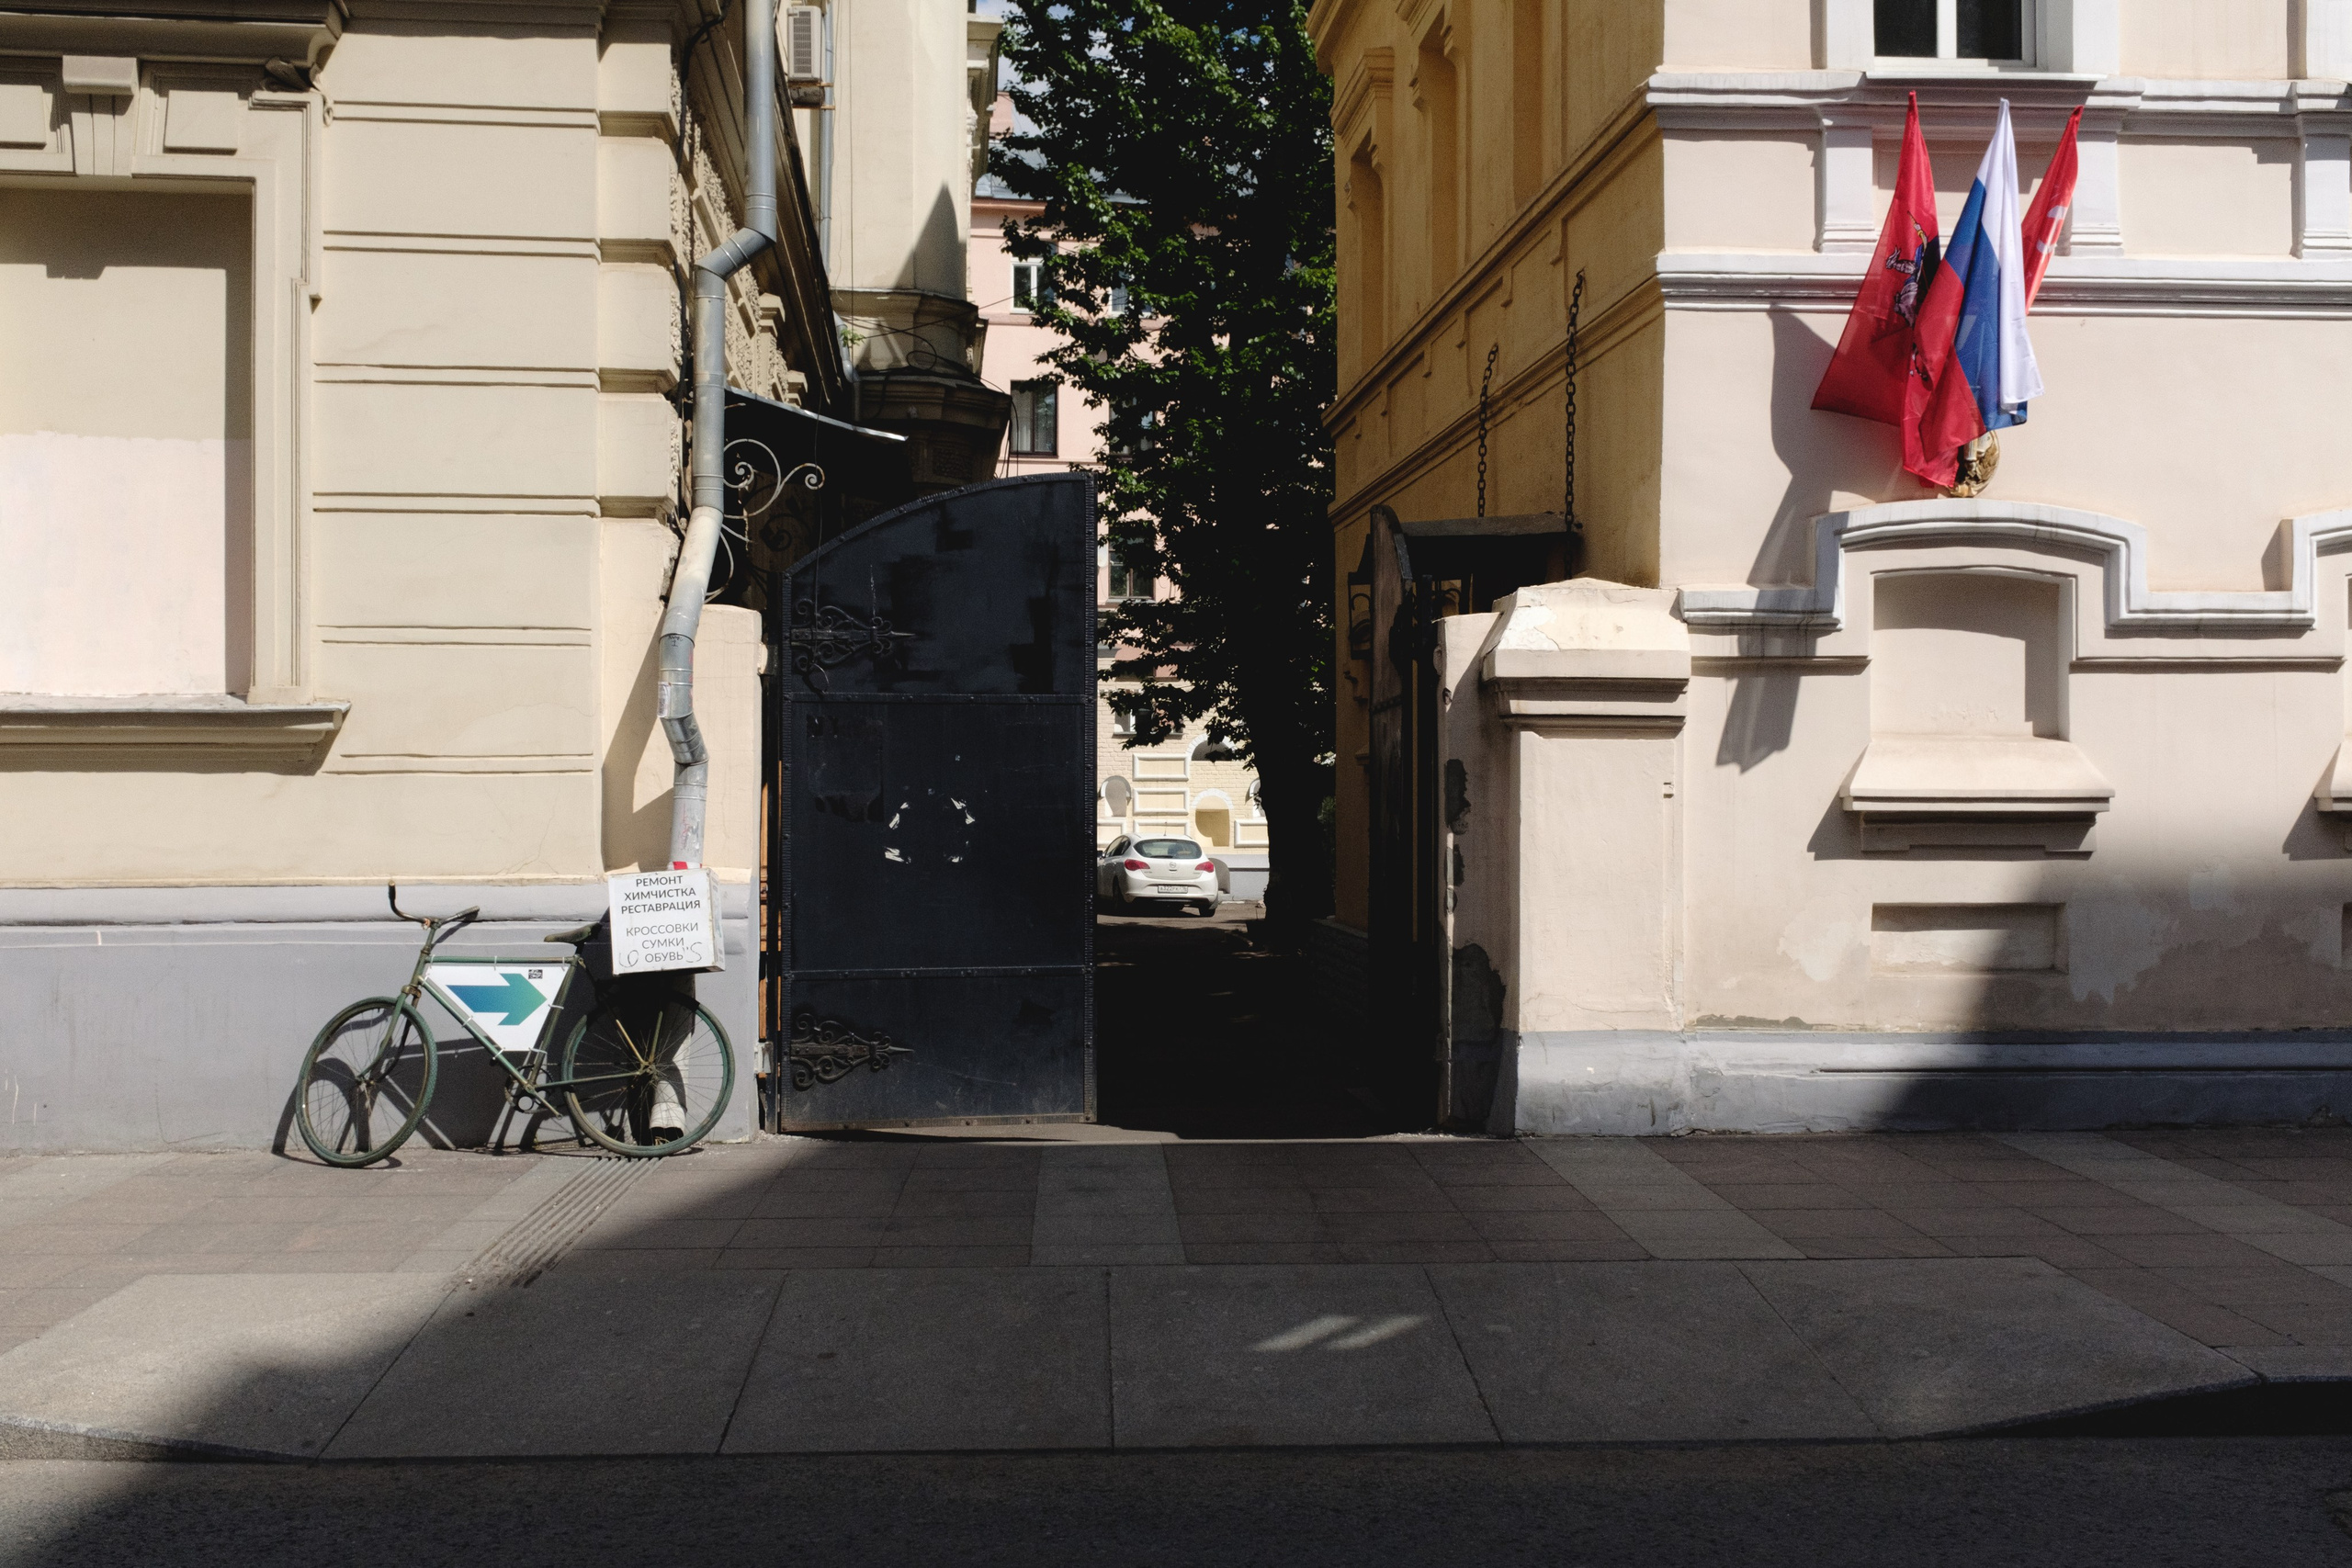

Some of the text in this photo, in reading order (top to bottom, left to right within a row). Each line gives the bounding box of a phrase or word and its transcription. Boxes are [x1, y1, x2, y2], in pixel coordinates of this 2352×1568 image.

[636, 875, 684, 887] РЕМОНТ
[625, 887, 696, 901] ХИМЧИСТКА
[621, 900, 701, 914] РЕСТАВРАЦИЯ
[626, 922, 699, 937] КРОССОВКИ
[641, 937, 684, 949] СУМКИ
[644, 951, 684, 963] ОБУВЬ
